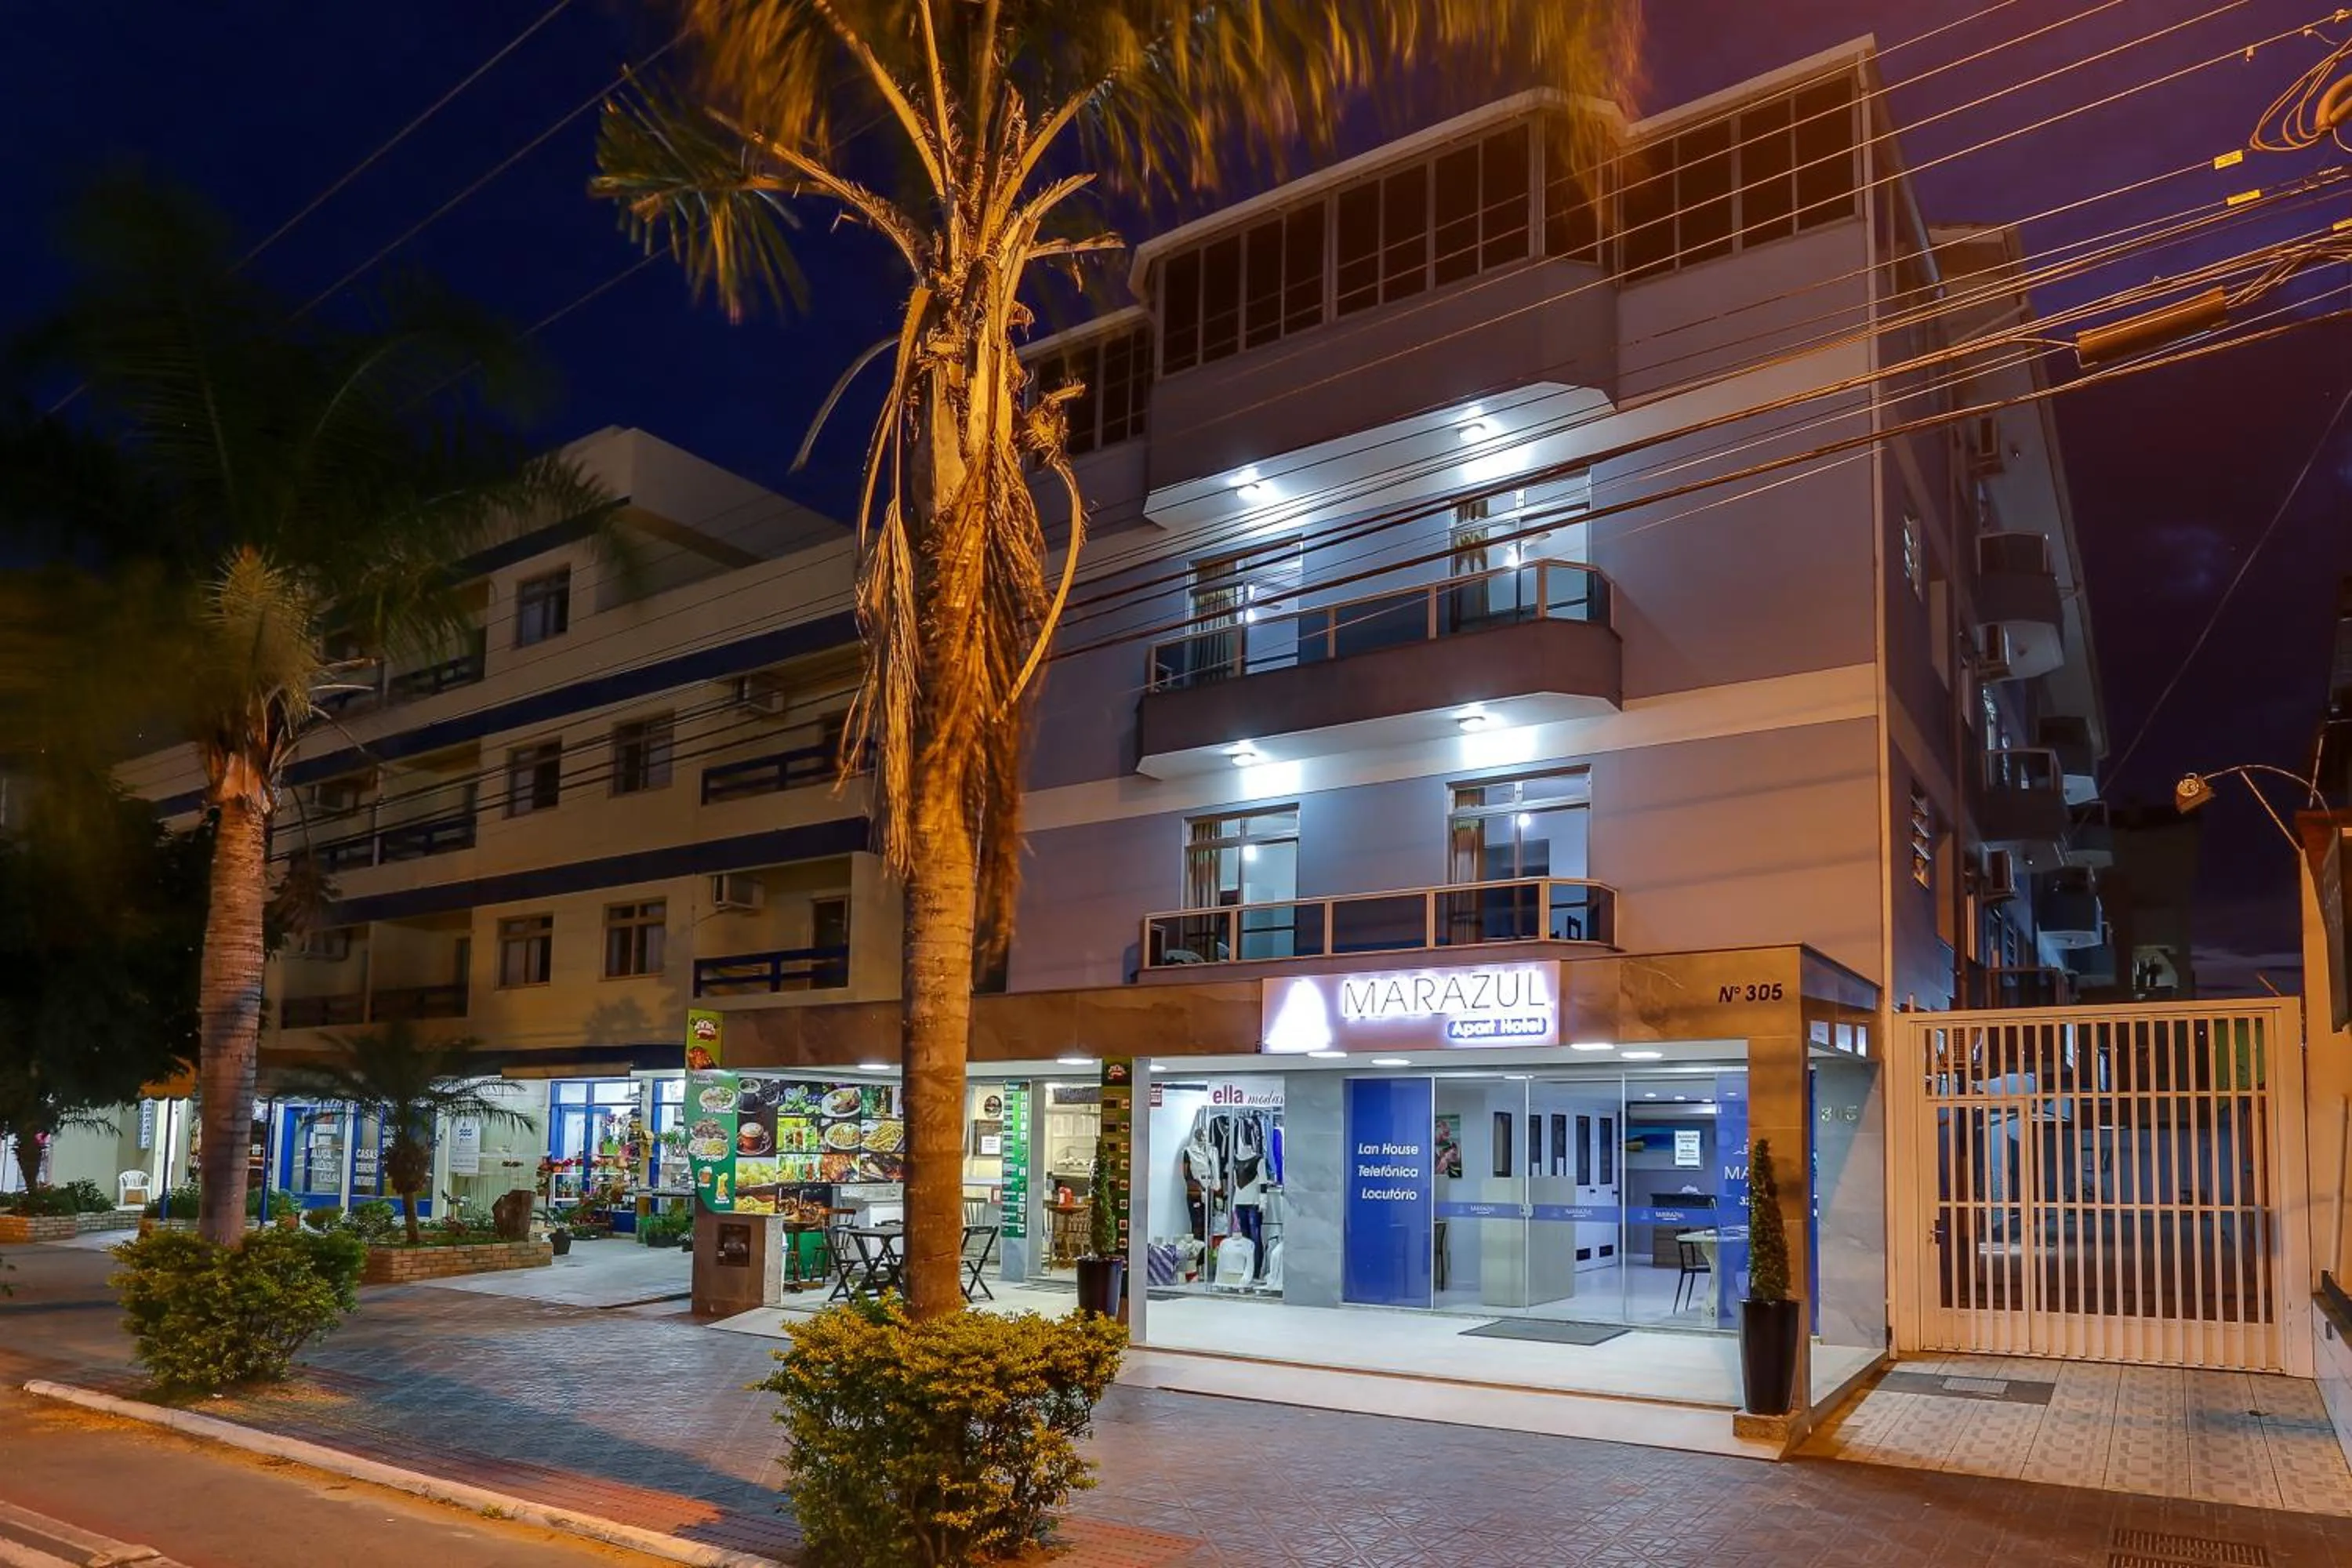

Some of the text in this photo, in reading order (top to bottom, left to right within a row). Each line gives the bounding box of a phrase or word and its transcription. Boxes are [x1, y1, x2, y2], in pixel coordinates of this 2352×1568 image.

[1344, 972, 1545, 1014] MARAZUL
[1745, 983, 1784, 1001] 305
[1450, 1018, 1544, 1037] Apart Hotel
[1213, 1084, 1243, 1104] ella
[1358, 1142, 1418, 1155] Lan House
[1358, 1164, 1418, 1178] Telefônica
[1362, 1187, 1417, 1200] Locutório
